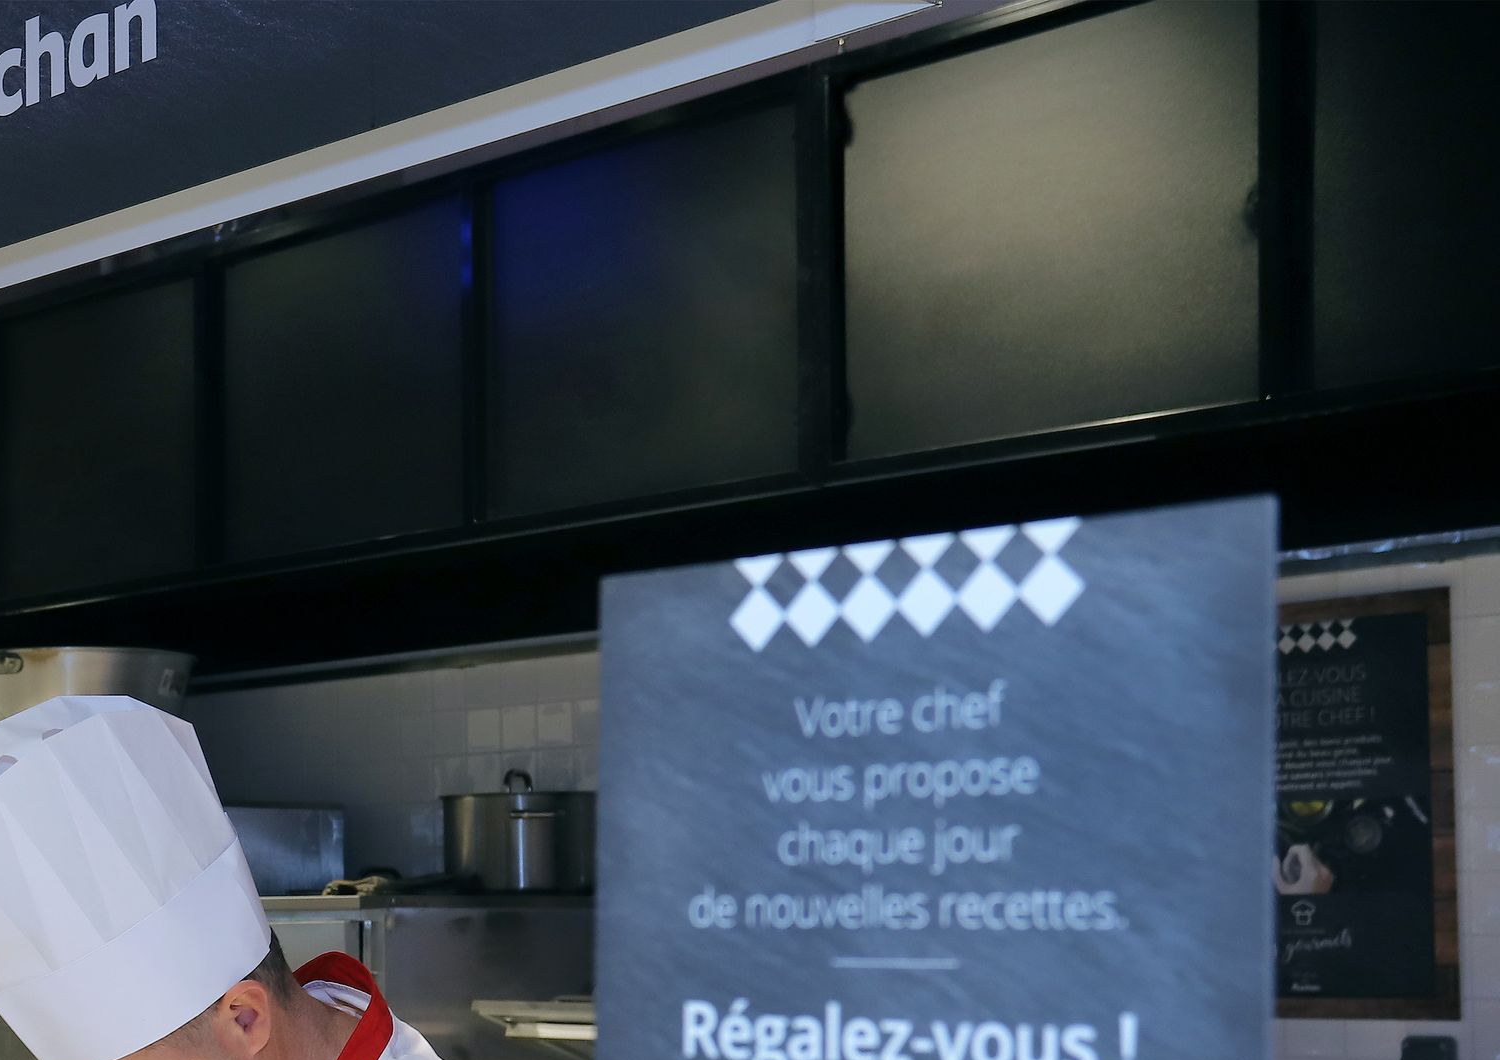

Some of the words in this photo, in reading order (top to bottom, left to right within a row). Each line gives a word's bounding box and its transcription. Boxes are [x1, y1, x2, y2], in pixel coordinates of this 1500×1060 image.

[794, 694, 903, 739] Votre
[911, 679, 1008, 733] chef
[762, 763, 855, 803] vous
[863, 755, 1041, 809] propose
[777, 820, 925, 874] chaque
[929, 818, 1022, 876] jour
[688, 884, 738, 930] de
[744, 883, 930, 931] nouvelles
